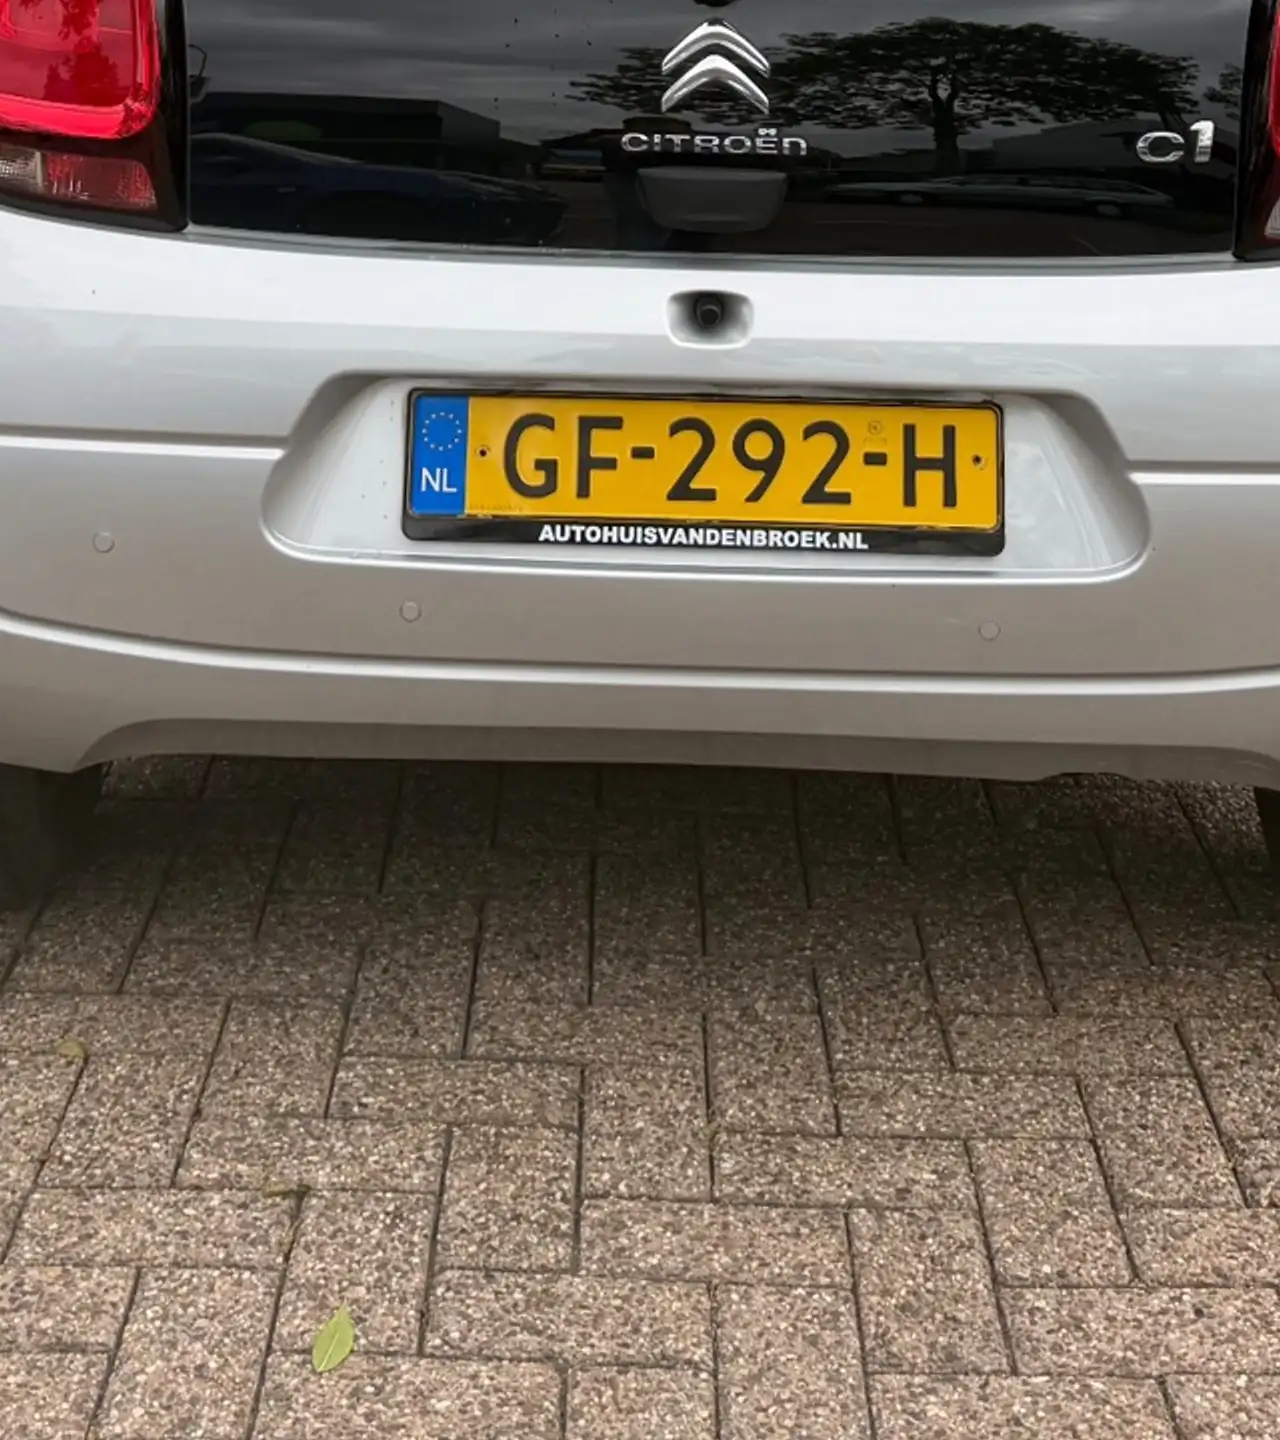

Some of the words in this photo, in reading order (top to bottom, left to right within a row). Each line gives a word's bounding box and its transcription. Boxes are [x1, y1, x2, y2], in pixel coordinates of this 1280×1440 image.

[1136, 120, 1216, 163] C1
[504, 412, 957, 508] GF-292-H
[421, 467, 458, 493] NL
[538, 524, 869, 550] AUTOHUISVANDENBROEK.NL
